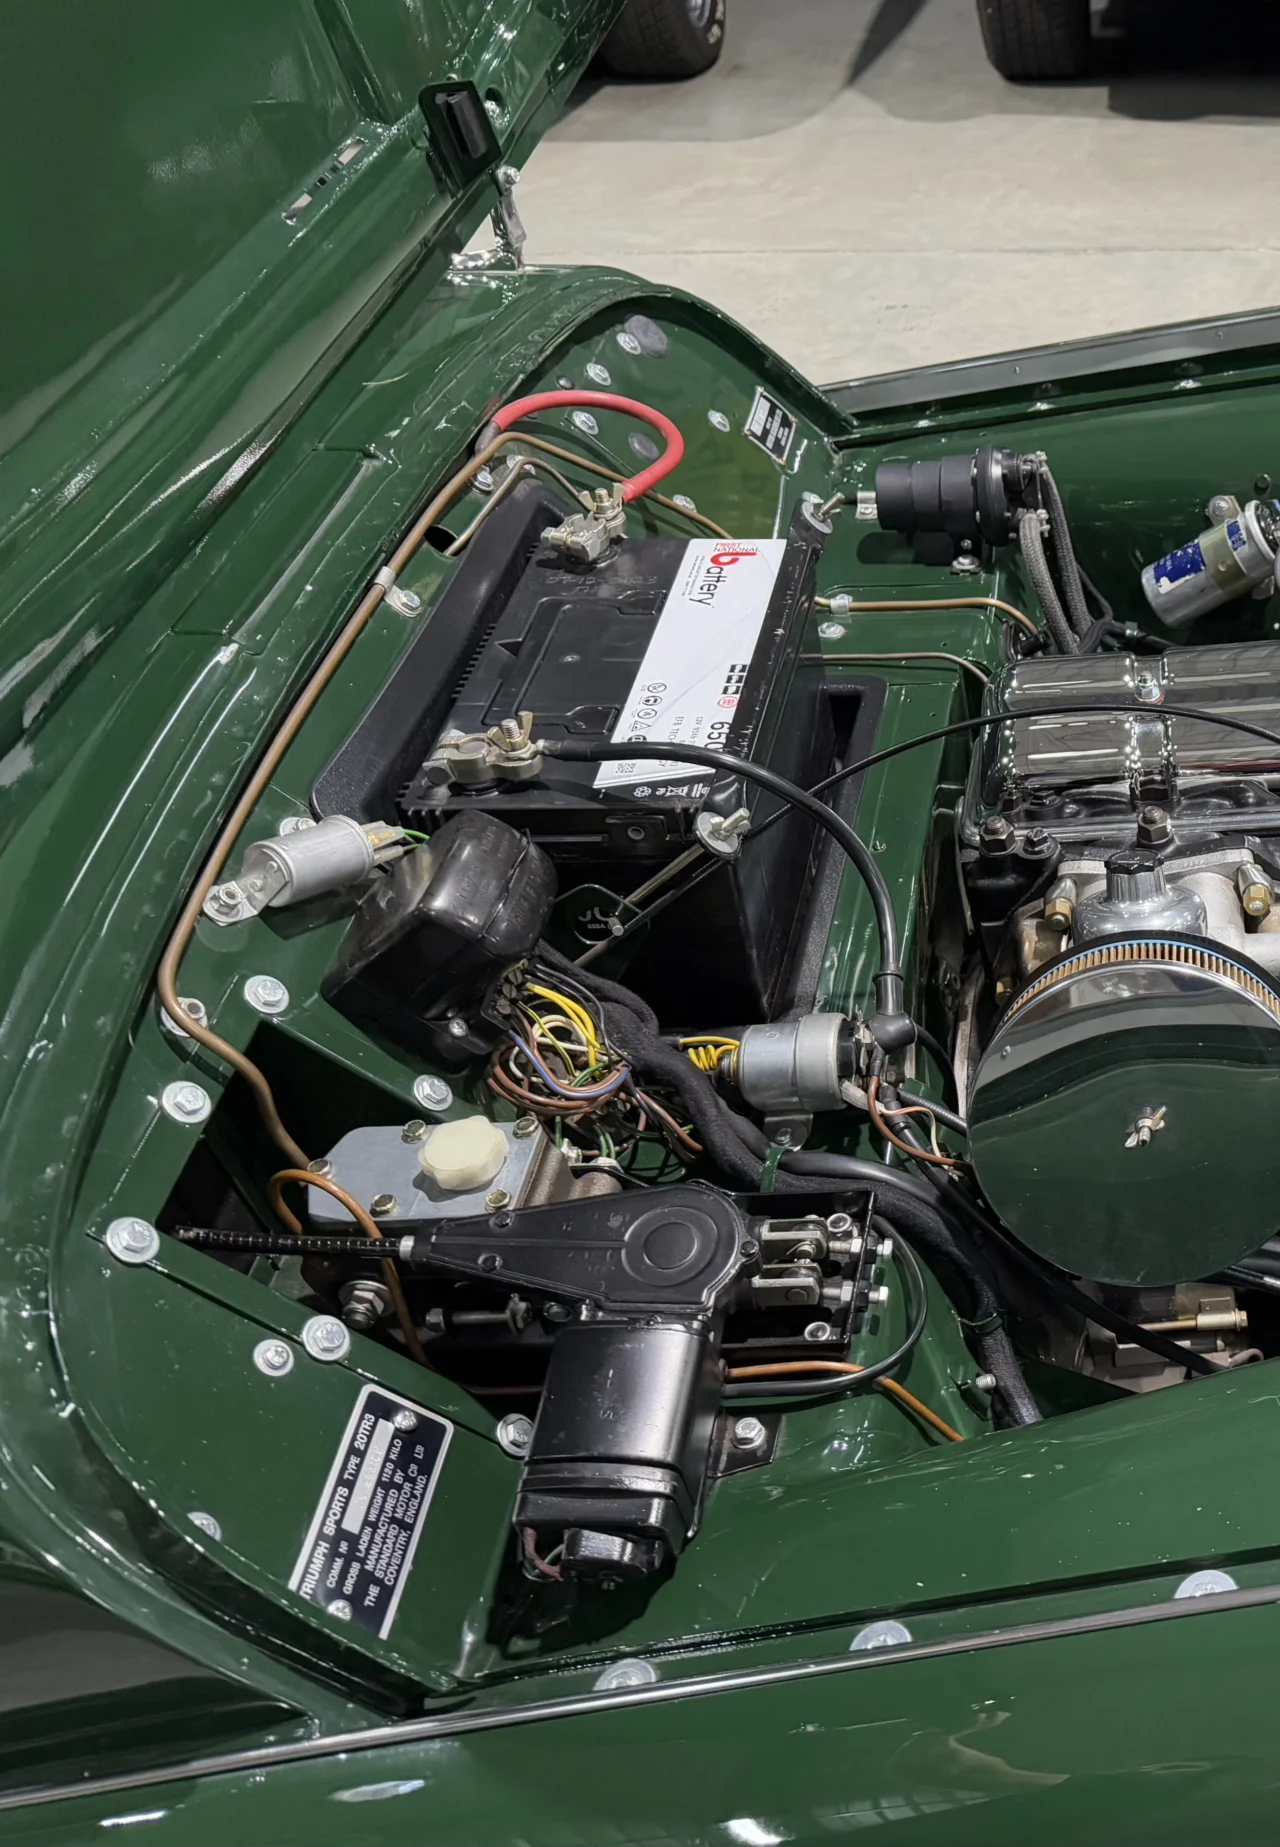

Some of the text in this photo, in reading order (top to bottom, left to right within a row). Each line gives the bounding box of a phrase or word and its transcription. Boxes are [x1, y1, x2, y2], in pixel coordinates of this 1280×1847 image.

[299, 1540, 330, 1600] TRIUMPH
[323, 1485, 349, 1536] SPORTS
[343, 1454, 360, 1480] TYPE
[353, 1413, 375, 1451] 20TR3
[342, 1561, 361, 1595] GROSS
[355, 1525, 373, 1558] LADEN
[367, 1487, 386, 1522] WEIGHT
[381, 1462, 394, 1482] 1120
[388, 1438, 402, 1460] KILO
[363, 1583, 380, 1607] THE
[374, 1523, 399, 1579] STANDARD
[394, 1481, 413, 1519] MOTOR
[364, 1488, 399, 1572] MANUFACTURED
[393, 1468, 405, 1484] BY
[404, 1474, 428, 1524] ENGLAND.
[326, 1557, 345, 1588] COMM.
